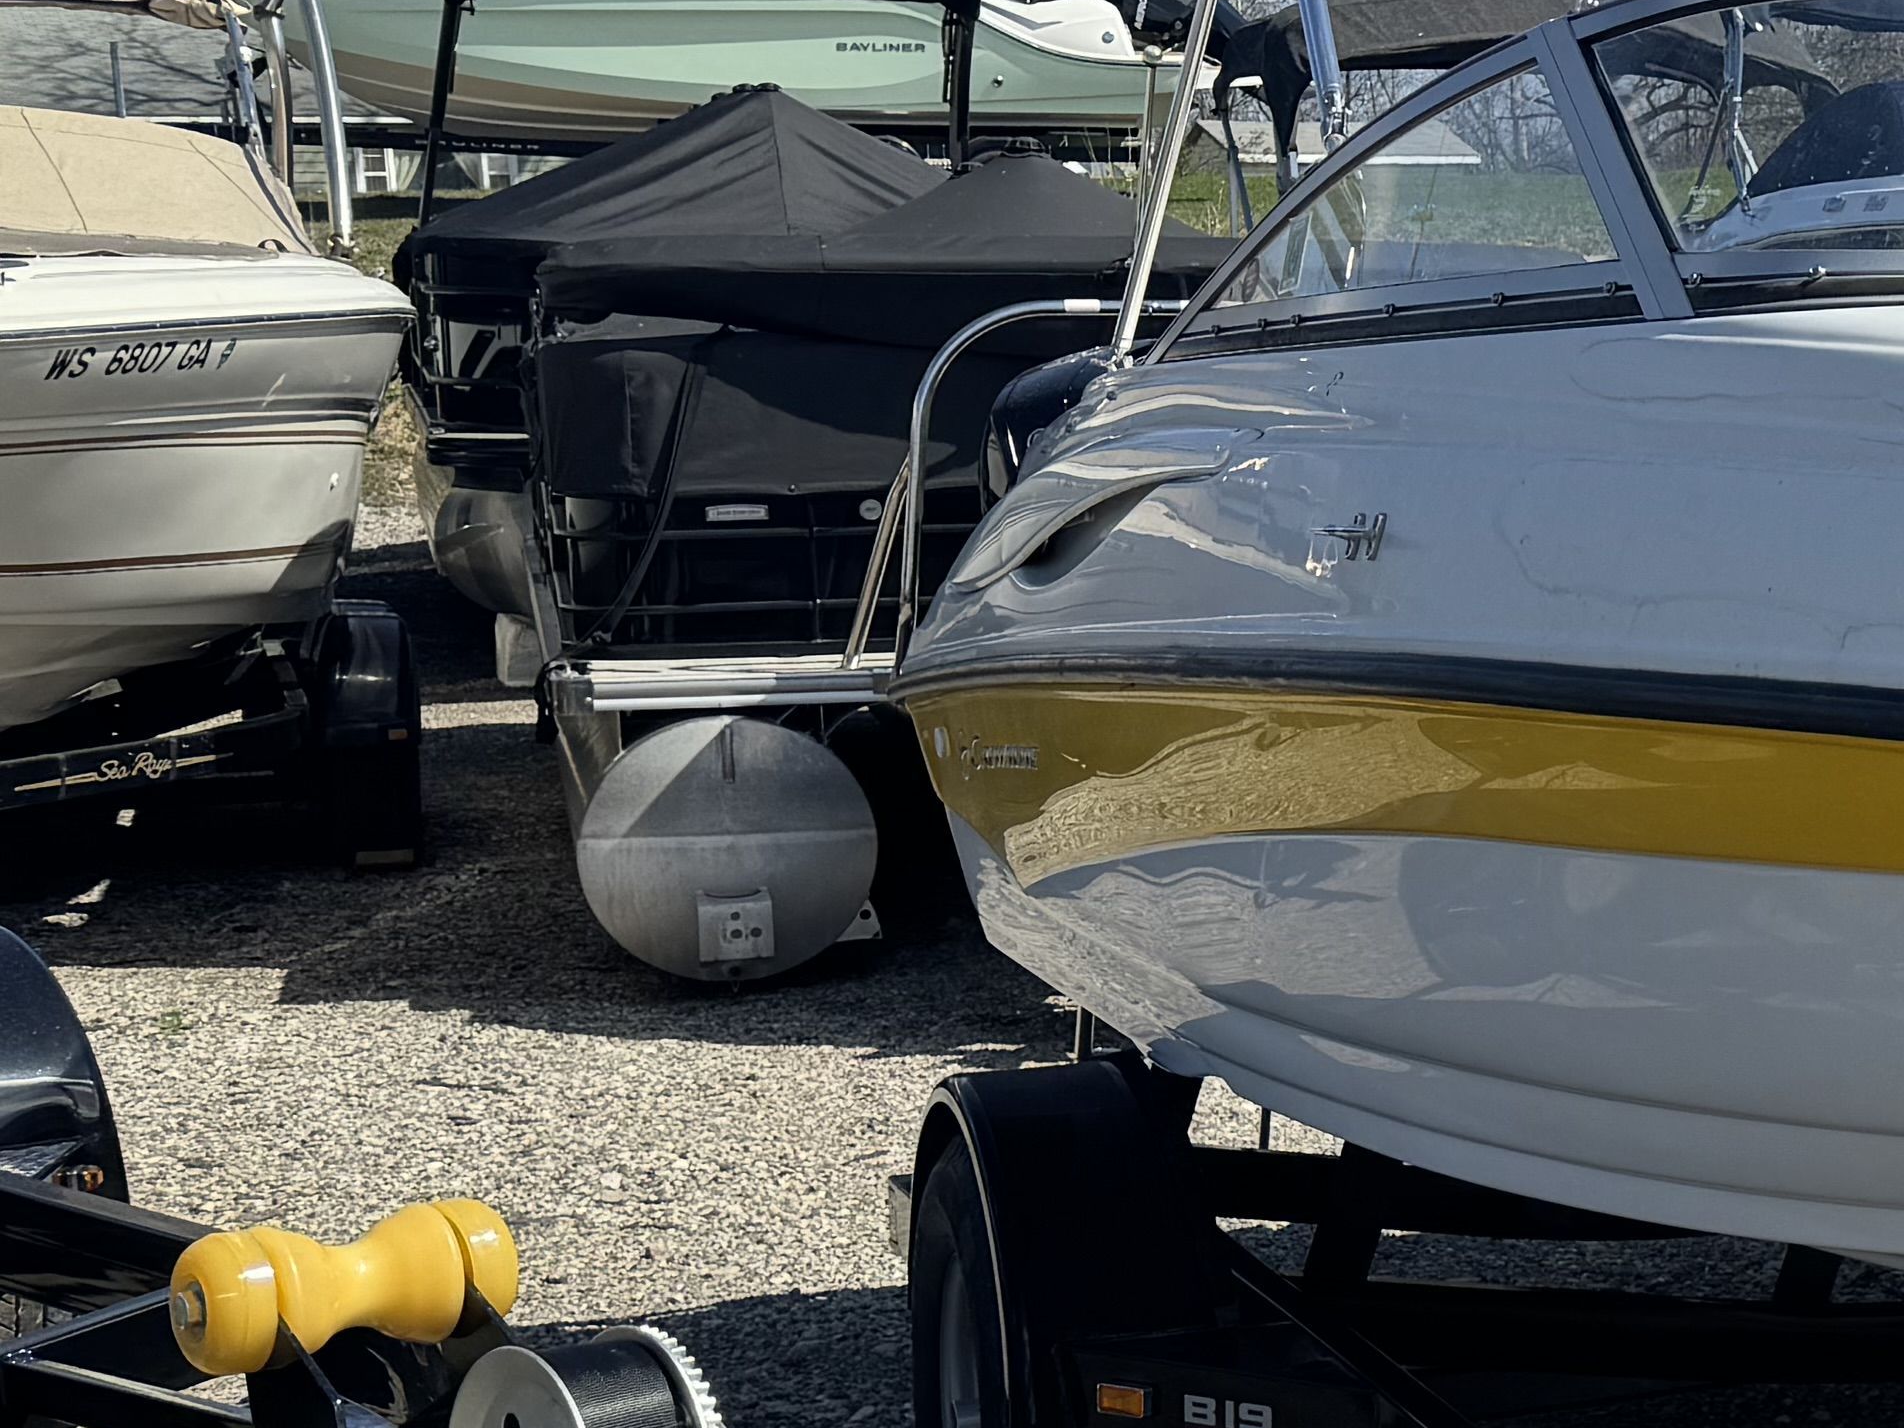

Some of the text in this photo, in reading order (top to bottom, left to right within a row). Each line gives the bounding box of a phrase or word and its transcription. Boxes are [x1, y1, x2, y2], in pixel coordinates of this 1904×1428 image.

[835, 42, 926, 53] BAYLINER
[44, 338, 213, 380] WS 6807 GA
[95, 751, 166, 782] Sea Ray
